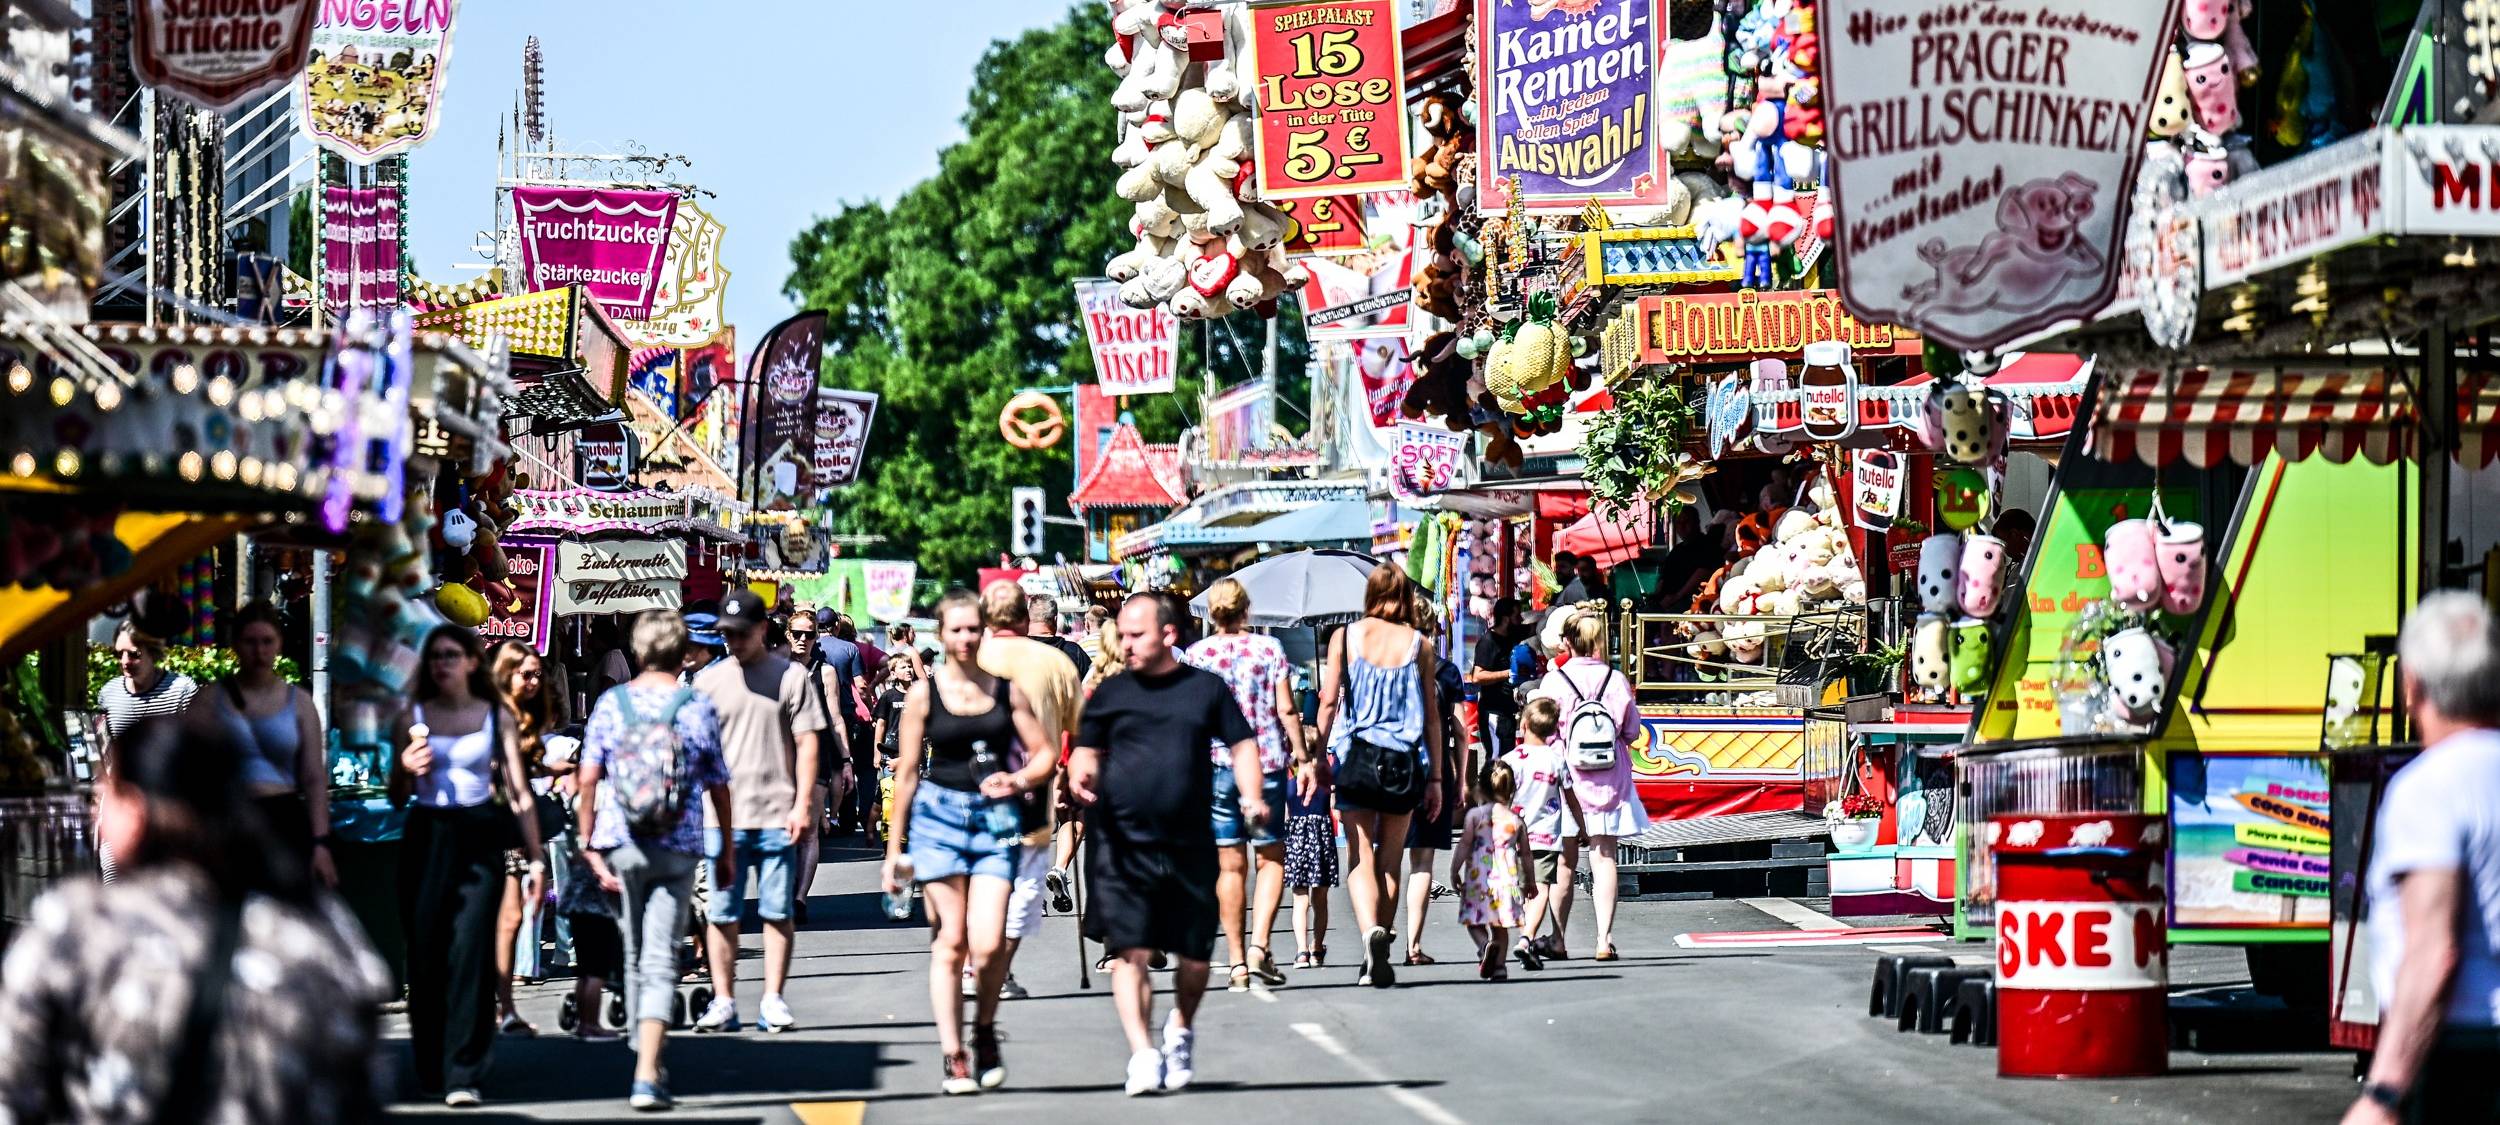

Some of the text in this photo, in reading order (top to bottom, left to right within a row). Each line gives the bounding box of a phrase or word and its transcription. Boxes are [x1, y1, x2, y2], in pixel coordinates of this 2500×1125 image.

[1274, 9, 1373, 32] SPIELPALAST
[1291, 30, 1363, 77] 15
[1497, 3, 1648, 73] Kamel-
[1910, 30, 2070, 88] PRAGER
[1263, 75, 1391, 112] Lose
[1496, 42, 1648, 118] Rennen
[1288, 108, 1375, 127] in der Tüte
[1559, 88, 1610, 122] jedem
[1500, 94, 1647, 178] Auswahl!
[1517, 109, 1599, 142] vollen Spiel
[1832, 87, 2144, 163] GRILLSCHINKEN
[1851, 165, 2005, 257] Krautsalat
[522, 216, 670, 245] Fruchtzucker
[533, 262, 653, 290] (Stärkezucker)
[1089, 308, 1175, 345] Back-
[1100, 346, 1169, 386] fisch
[1806, 387, 1844, 405] nutella
[816, 454, 851, 469] tella
[1402, 445, 1458, 465] SOFT
[1858, 464, 1896, 490] nutella
[508, 554, 538, 575] oko-
[577, 552, 671, 571] Zuckerwatte
[575, 581, 662, 606] Waffeltüten
